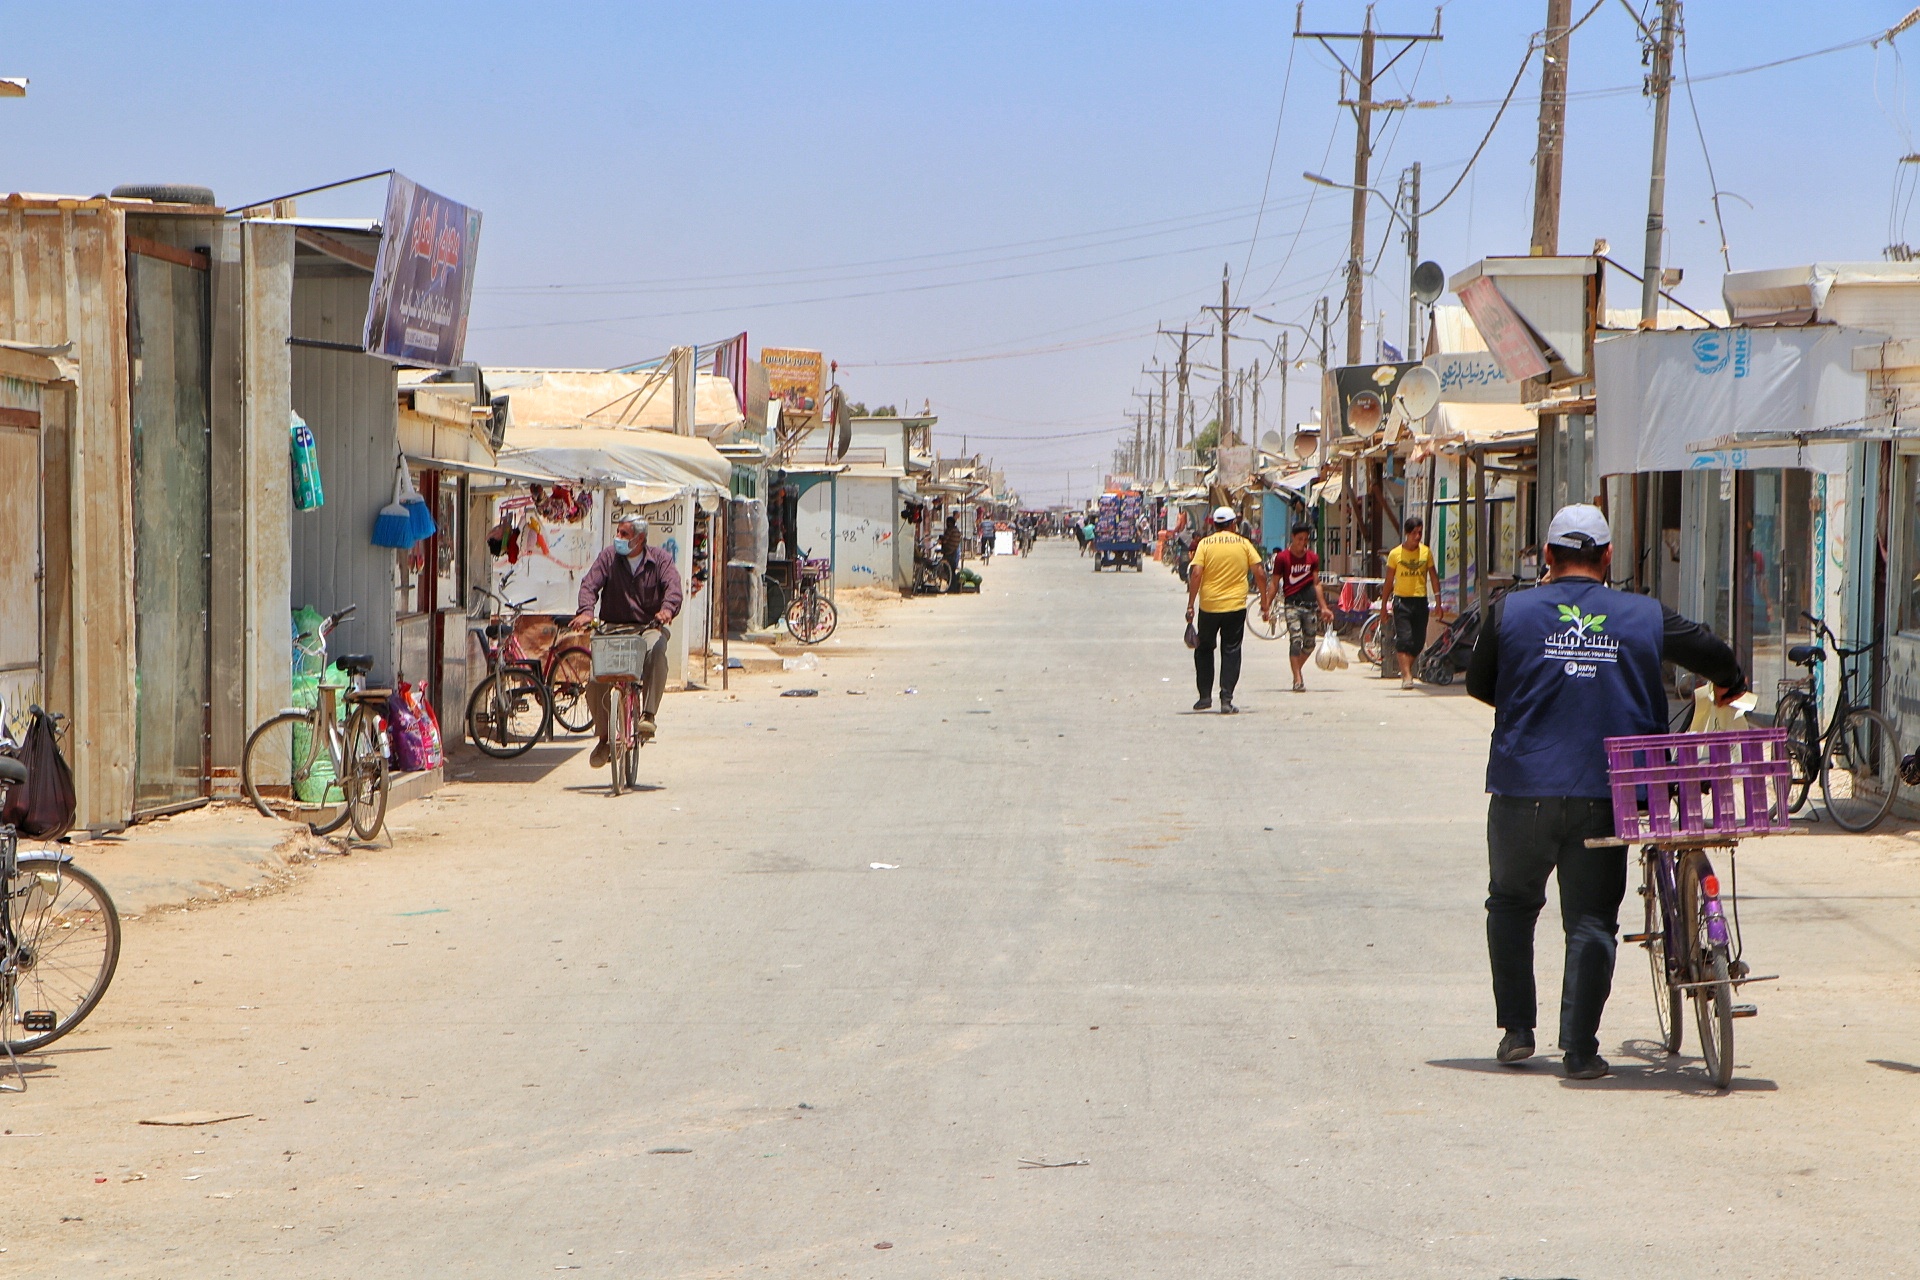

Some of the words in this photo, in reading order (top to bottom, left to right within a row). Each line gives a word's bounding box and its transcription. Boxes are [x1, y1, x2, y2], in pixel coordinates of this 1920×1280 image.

[1735, 327, 1747, 378] UNHC
[1291, 564, 1312, 573] NIKE
[1584, 634, 1619, 653] بيئتك
[1578, 664, 1597, 672] OXFAM
